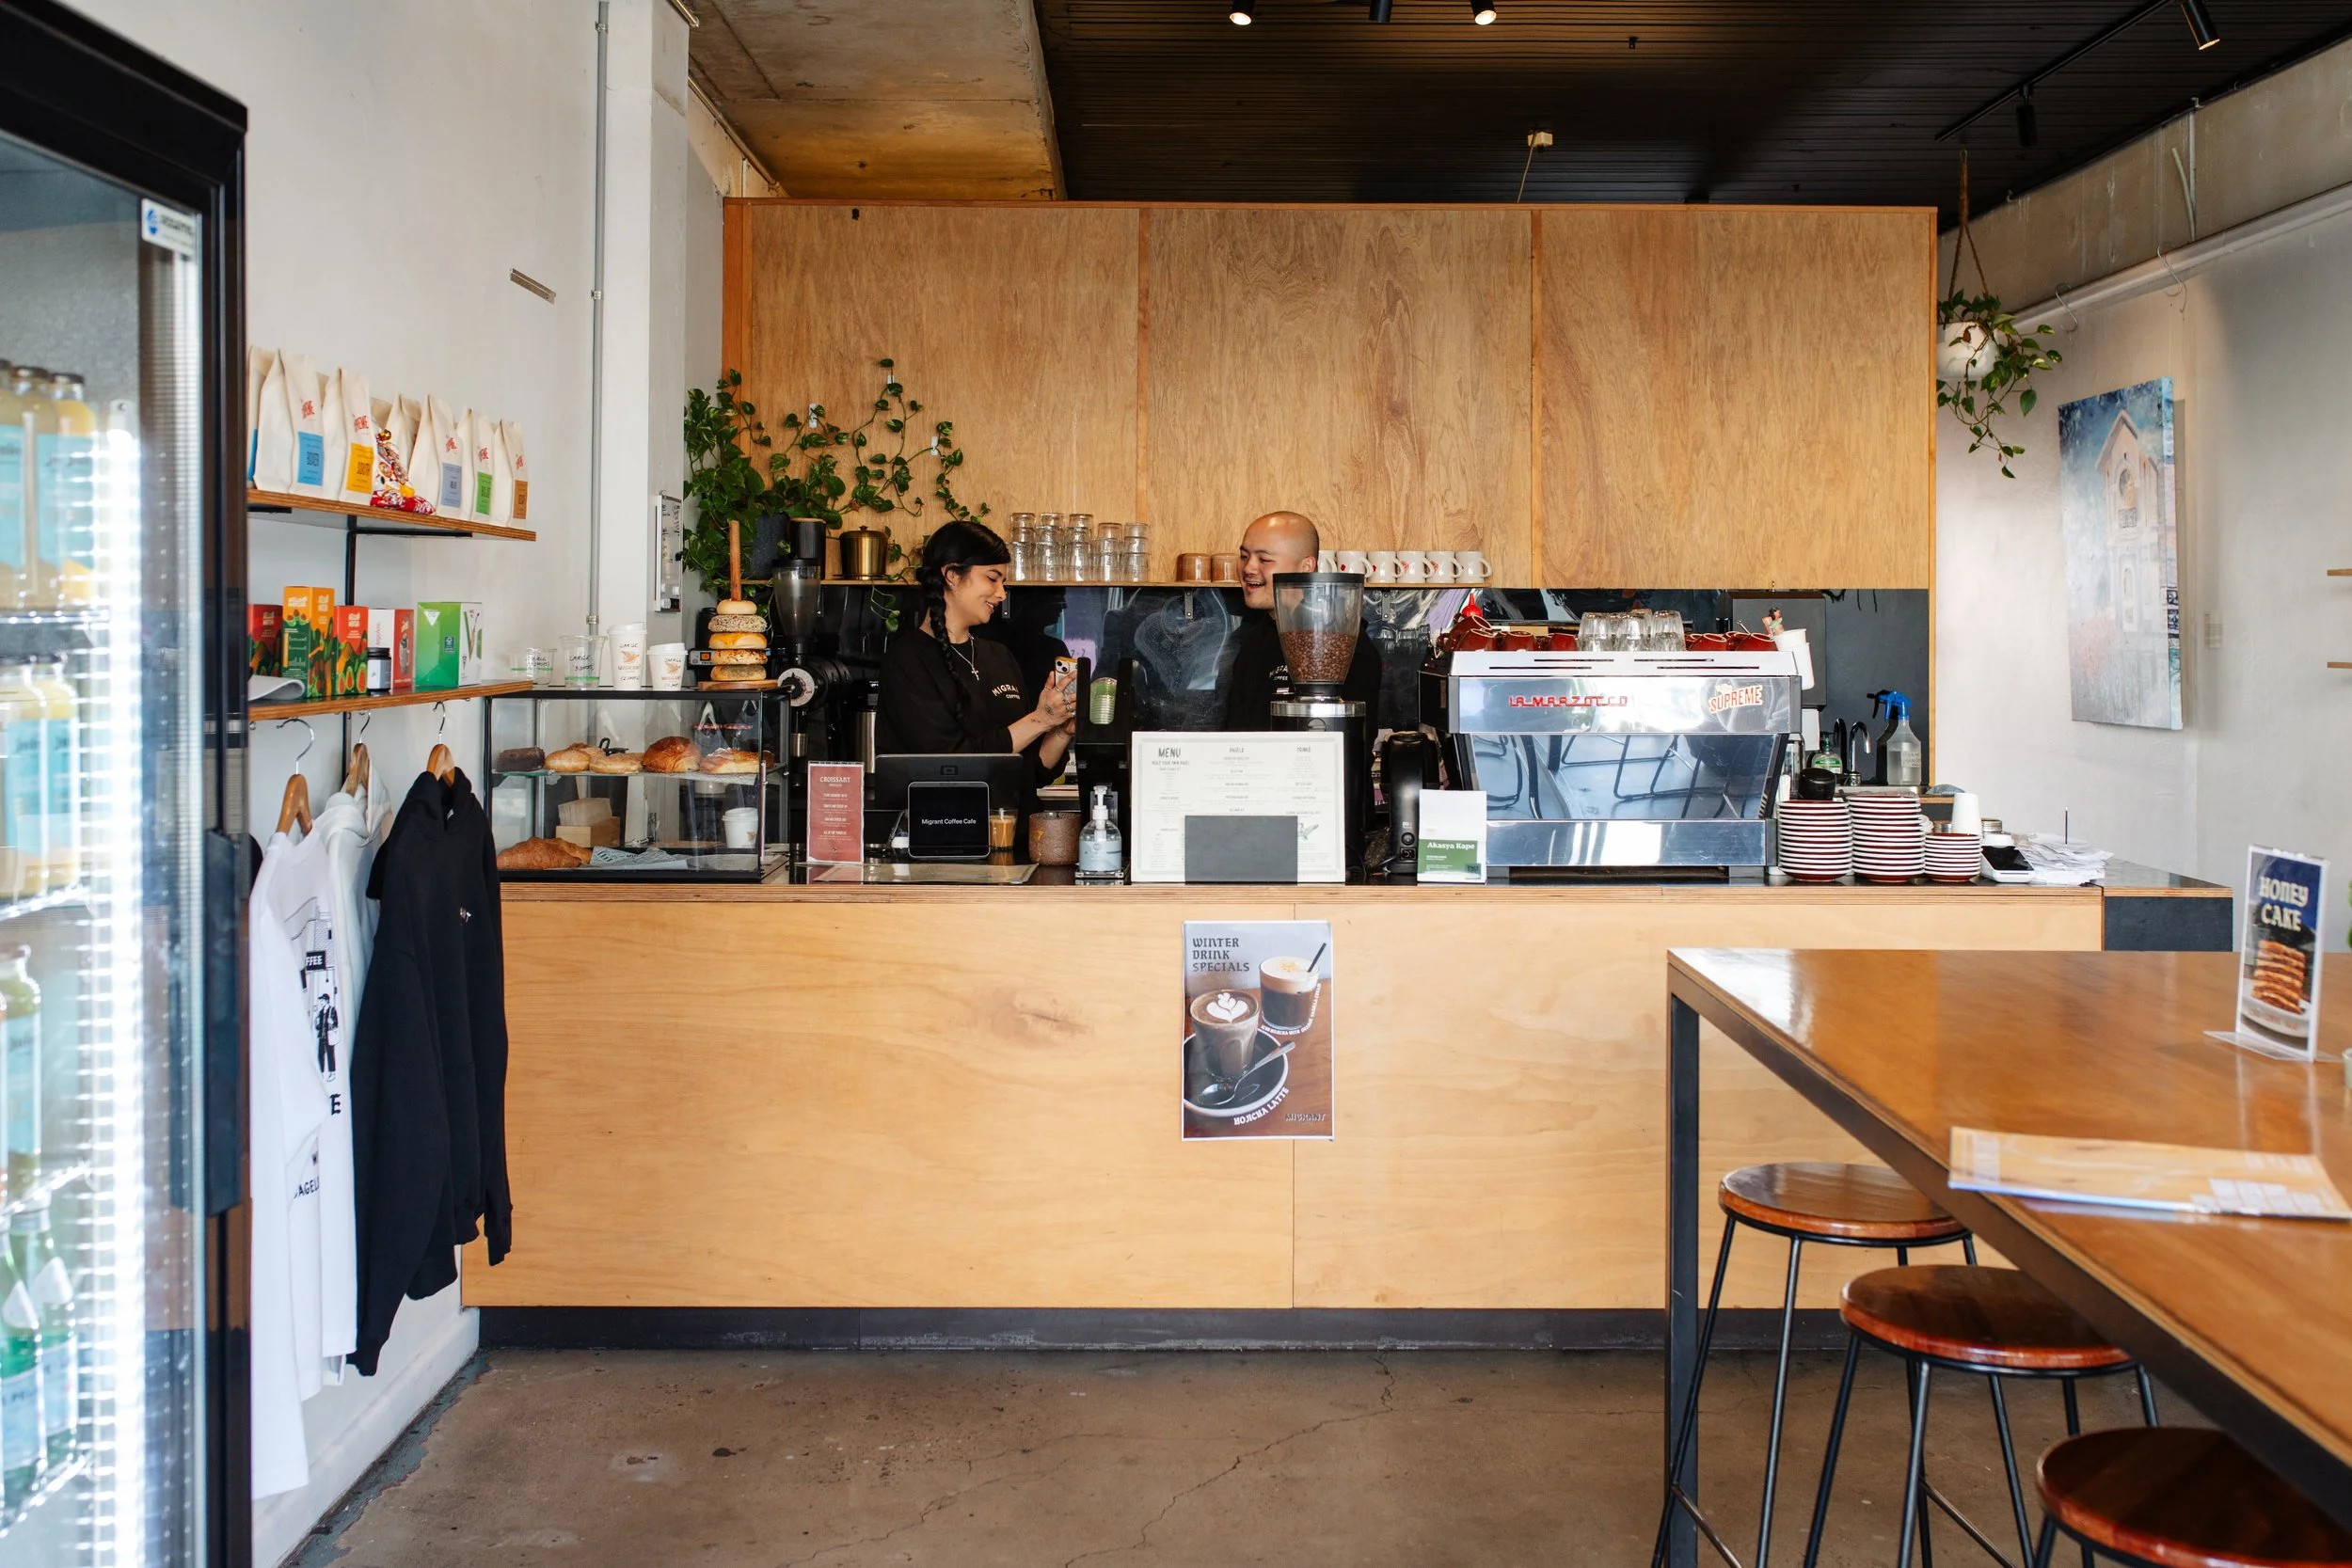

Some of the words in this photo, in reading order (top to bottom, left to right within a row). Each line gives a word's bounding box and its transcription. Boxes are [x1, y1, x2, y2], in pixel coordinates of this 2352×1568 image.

[992, 684, 1019, 697] MIGRA
[1709, 687, 1761, 712] SUPREME
[1158, 747, 1182, 758] MENU
[1427, 842, 1454, 850] Akasya
[1455, 842, 1475, 850] Kape
[2259, 877, 2310, 908] HONEY
[2261, 903, 2302, 931] CAKE
[1192, 938, 1240, 948] WINTER
[1192, 950, 1231, 960] DRINK
[1192, 962, 1250, 973] SPECIALS
[1233, 1107, 1268, 1126] HOJICHA
[1266, 1086, 1290, 1110] LATTE
[1285, 1113, 1327, 1122] MIGRANT
